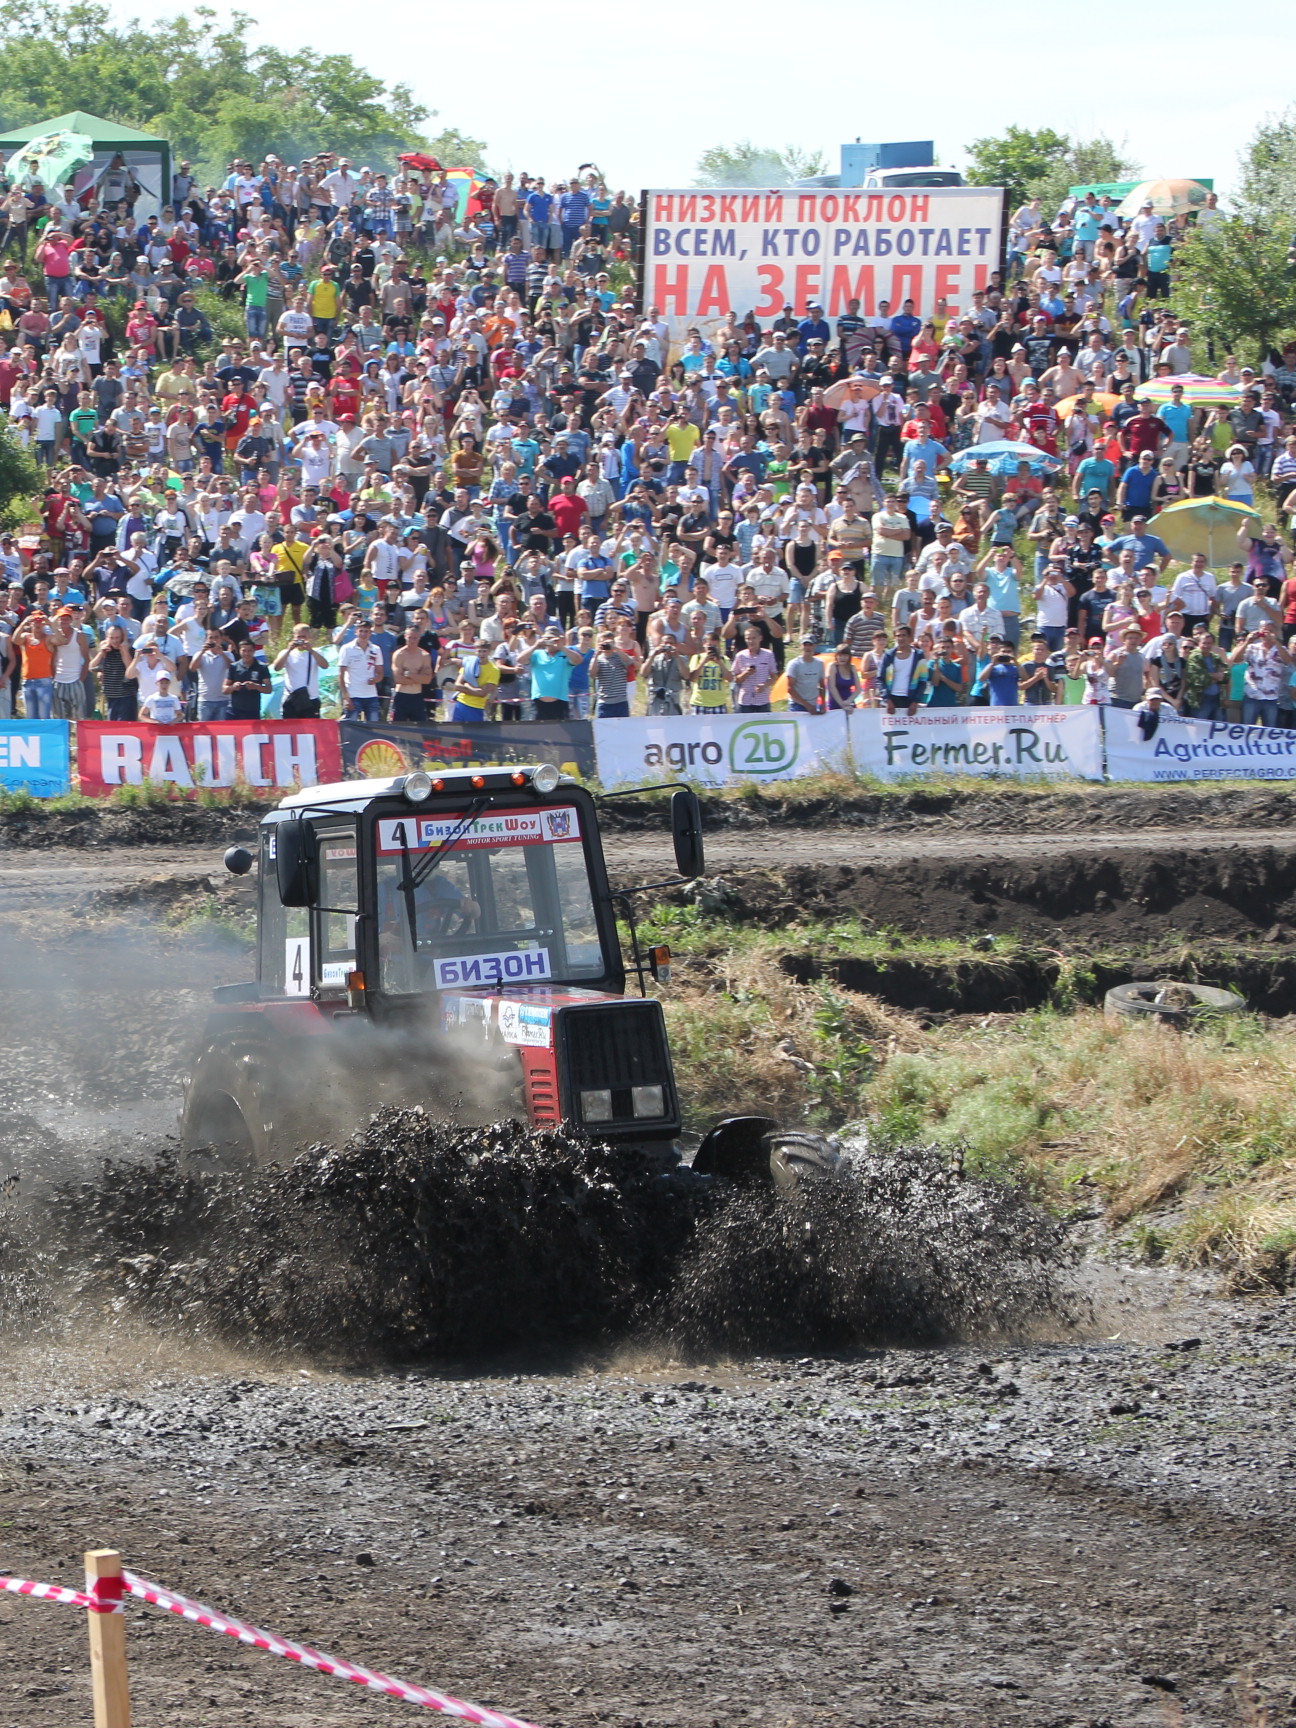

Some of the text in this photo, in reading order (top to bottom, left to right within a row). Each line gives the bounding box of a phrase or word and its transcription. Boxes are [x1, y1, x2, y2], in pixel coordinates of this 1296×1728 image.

[654, 189, 930, 223] НИЗКИЙ ПОКЛОН
[653, 227, 992, 261] ВСЕМ, КТО РАБОТАЕТ
[653, 263, 732, 317] НА
[882, 712, 1068, 727] ГЕНЕРАЛЬНЫЙ ИНТЕРНЕТ-ПАРТНЁР
[99, 733, 318, 788] RAUCH
[422, 738, 473, 758] Shell
[643, 731, 786, 774] agro 2b
[882, 727, 1069, 767] Fermer.Ru
[390, 821, 406, 847] 4
[466, 833, 540, 846] MOTOR SPORT TUNING
[292, 943, 304, 993] 4
[439, 952, 546, 985] БИЗОН
